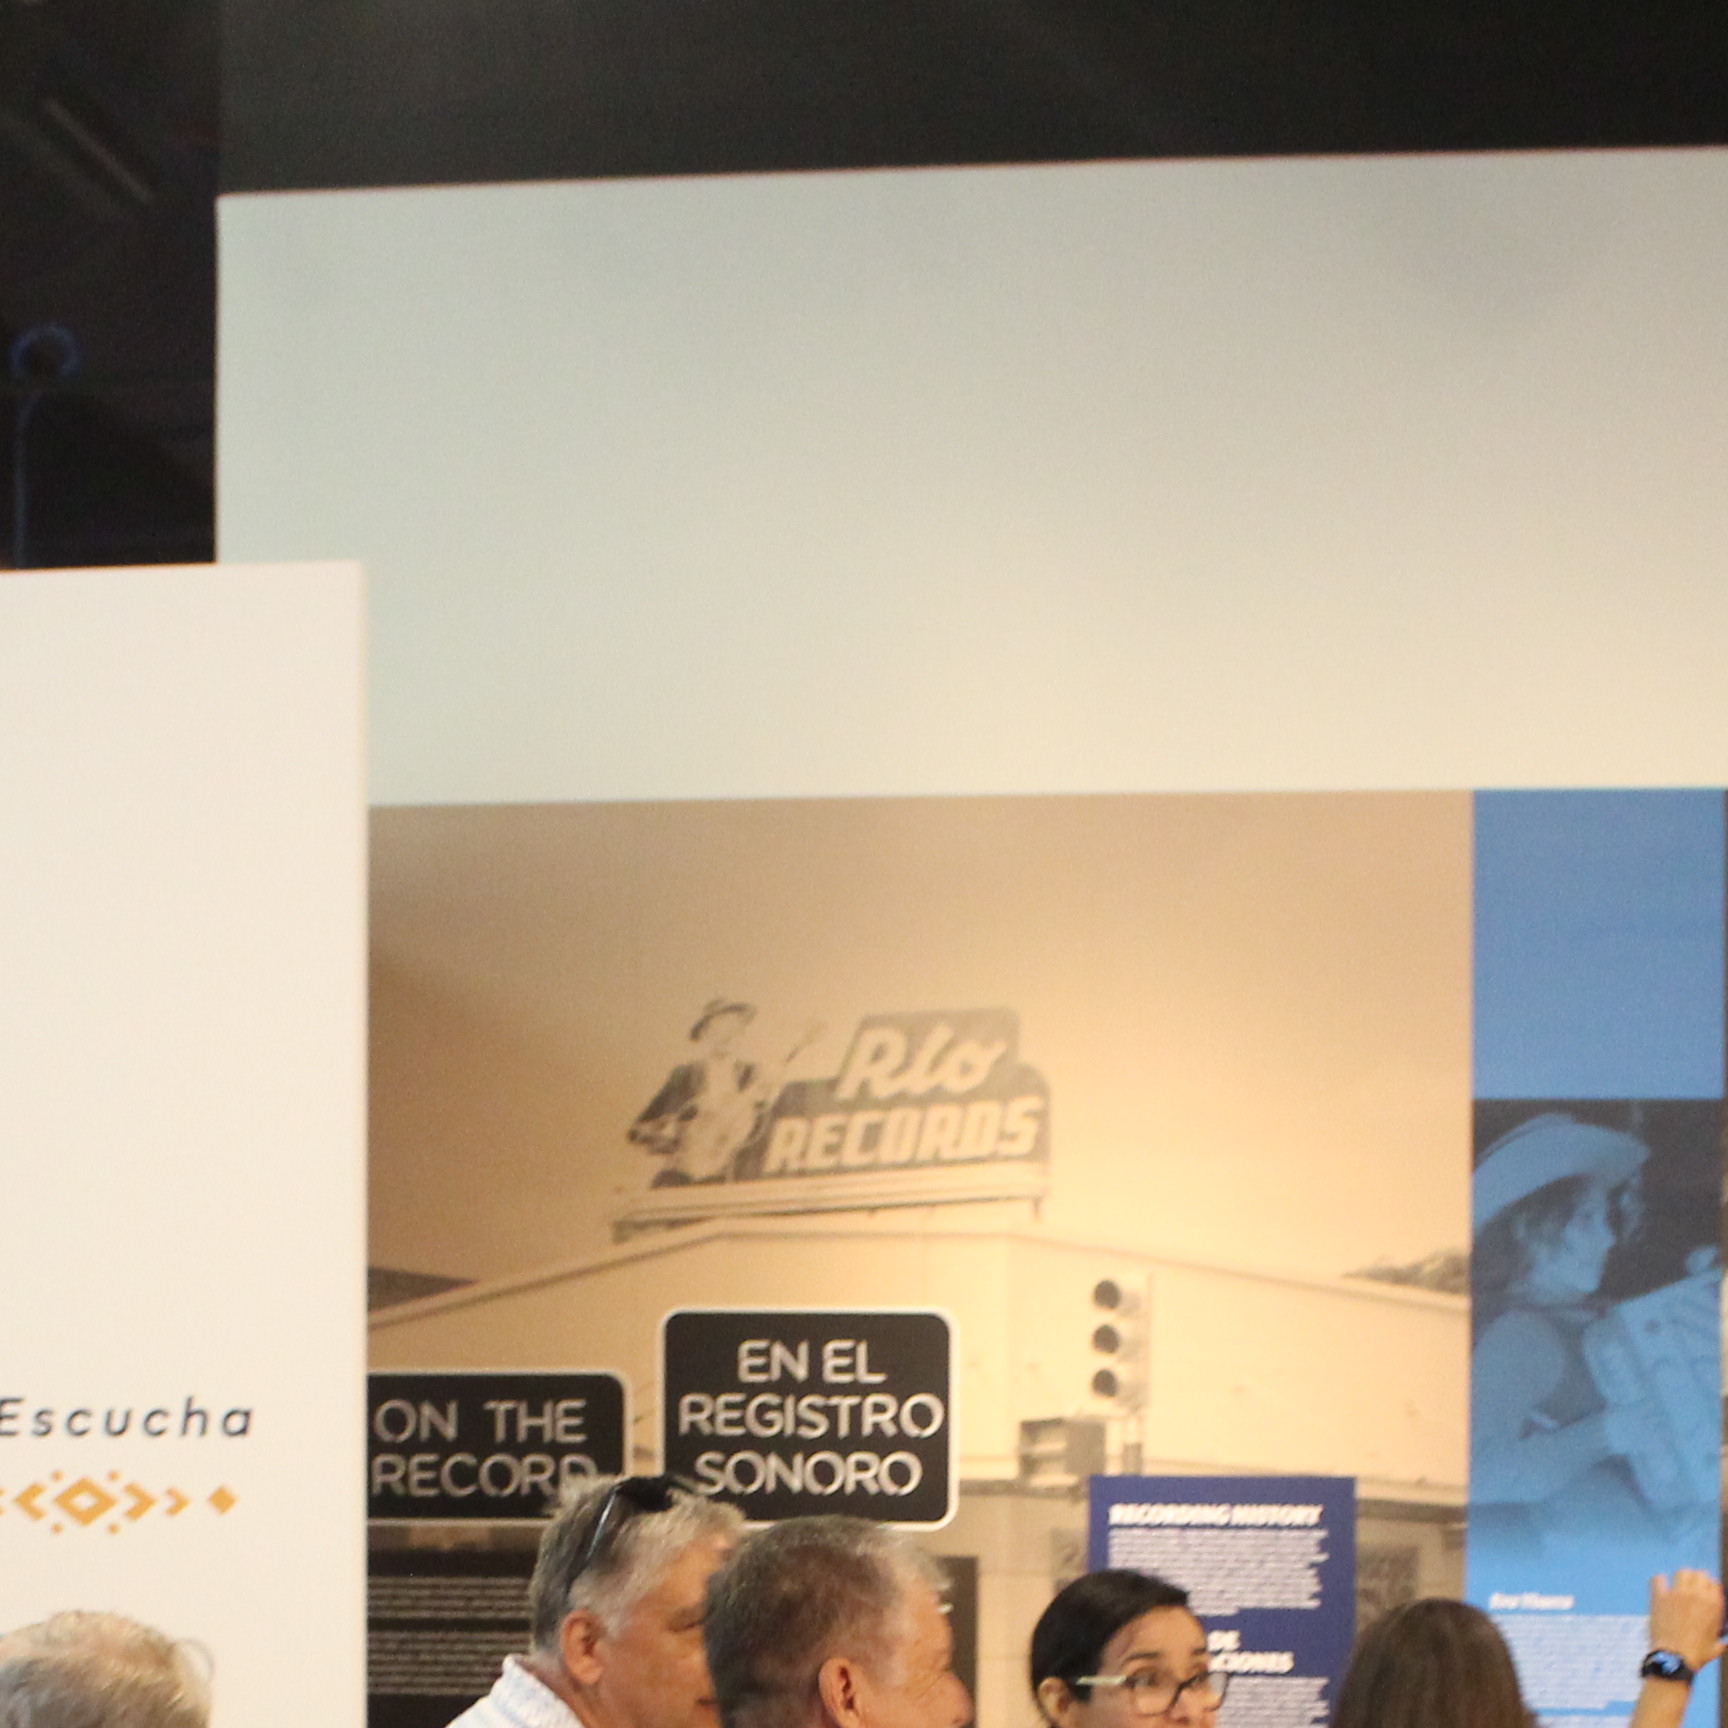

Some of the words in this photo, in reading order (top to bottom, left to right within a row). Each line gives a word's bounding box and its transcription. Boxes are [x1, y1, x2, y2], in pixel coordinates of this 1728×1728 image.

[764, 1095, 1043, 1174] RECORDS
[737, 1338, 810, 1385] EN
[822, 1339, 889, 1386] EL
[373, 1399, 459, 1444] ON
[484, 1399, 589, 1444] THE
[677, 1393, 945, 1440] REGISTRO
[694, 1450, 924, 1498] SONORO
